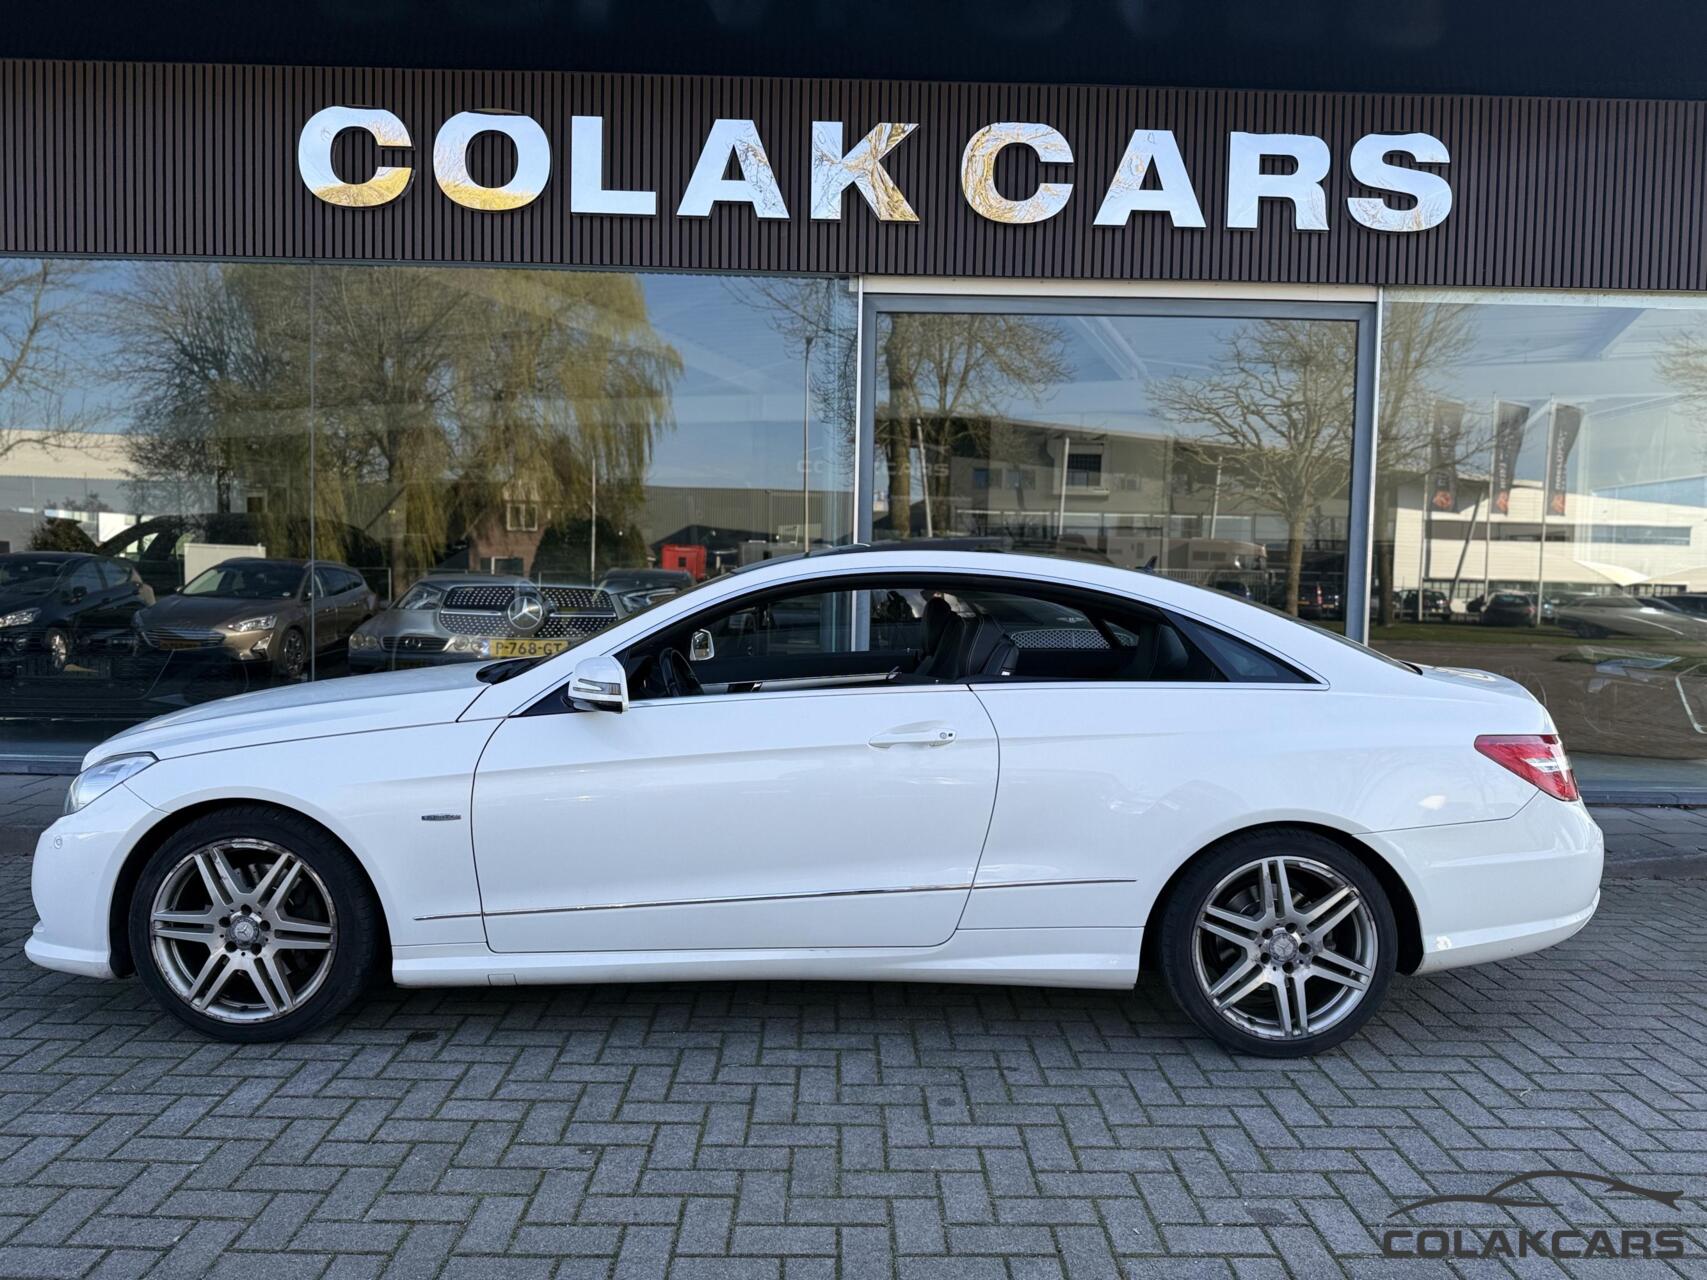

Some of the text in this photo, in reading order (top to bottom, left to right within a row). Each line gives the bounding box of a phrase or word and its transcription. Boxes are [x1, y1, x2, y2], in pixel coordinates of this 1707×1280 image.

[298, 105, 1453, 233] COLAK CARS
[495, 641, 562, 656] P-768-GT
